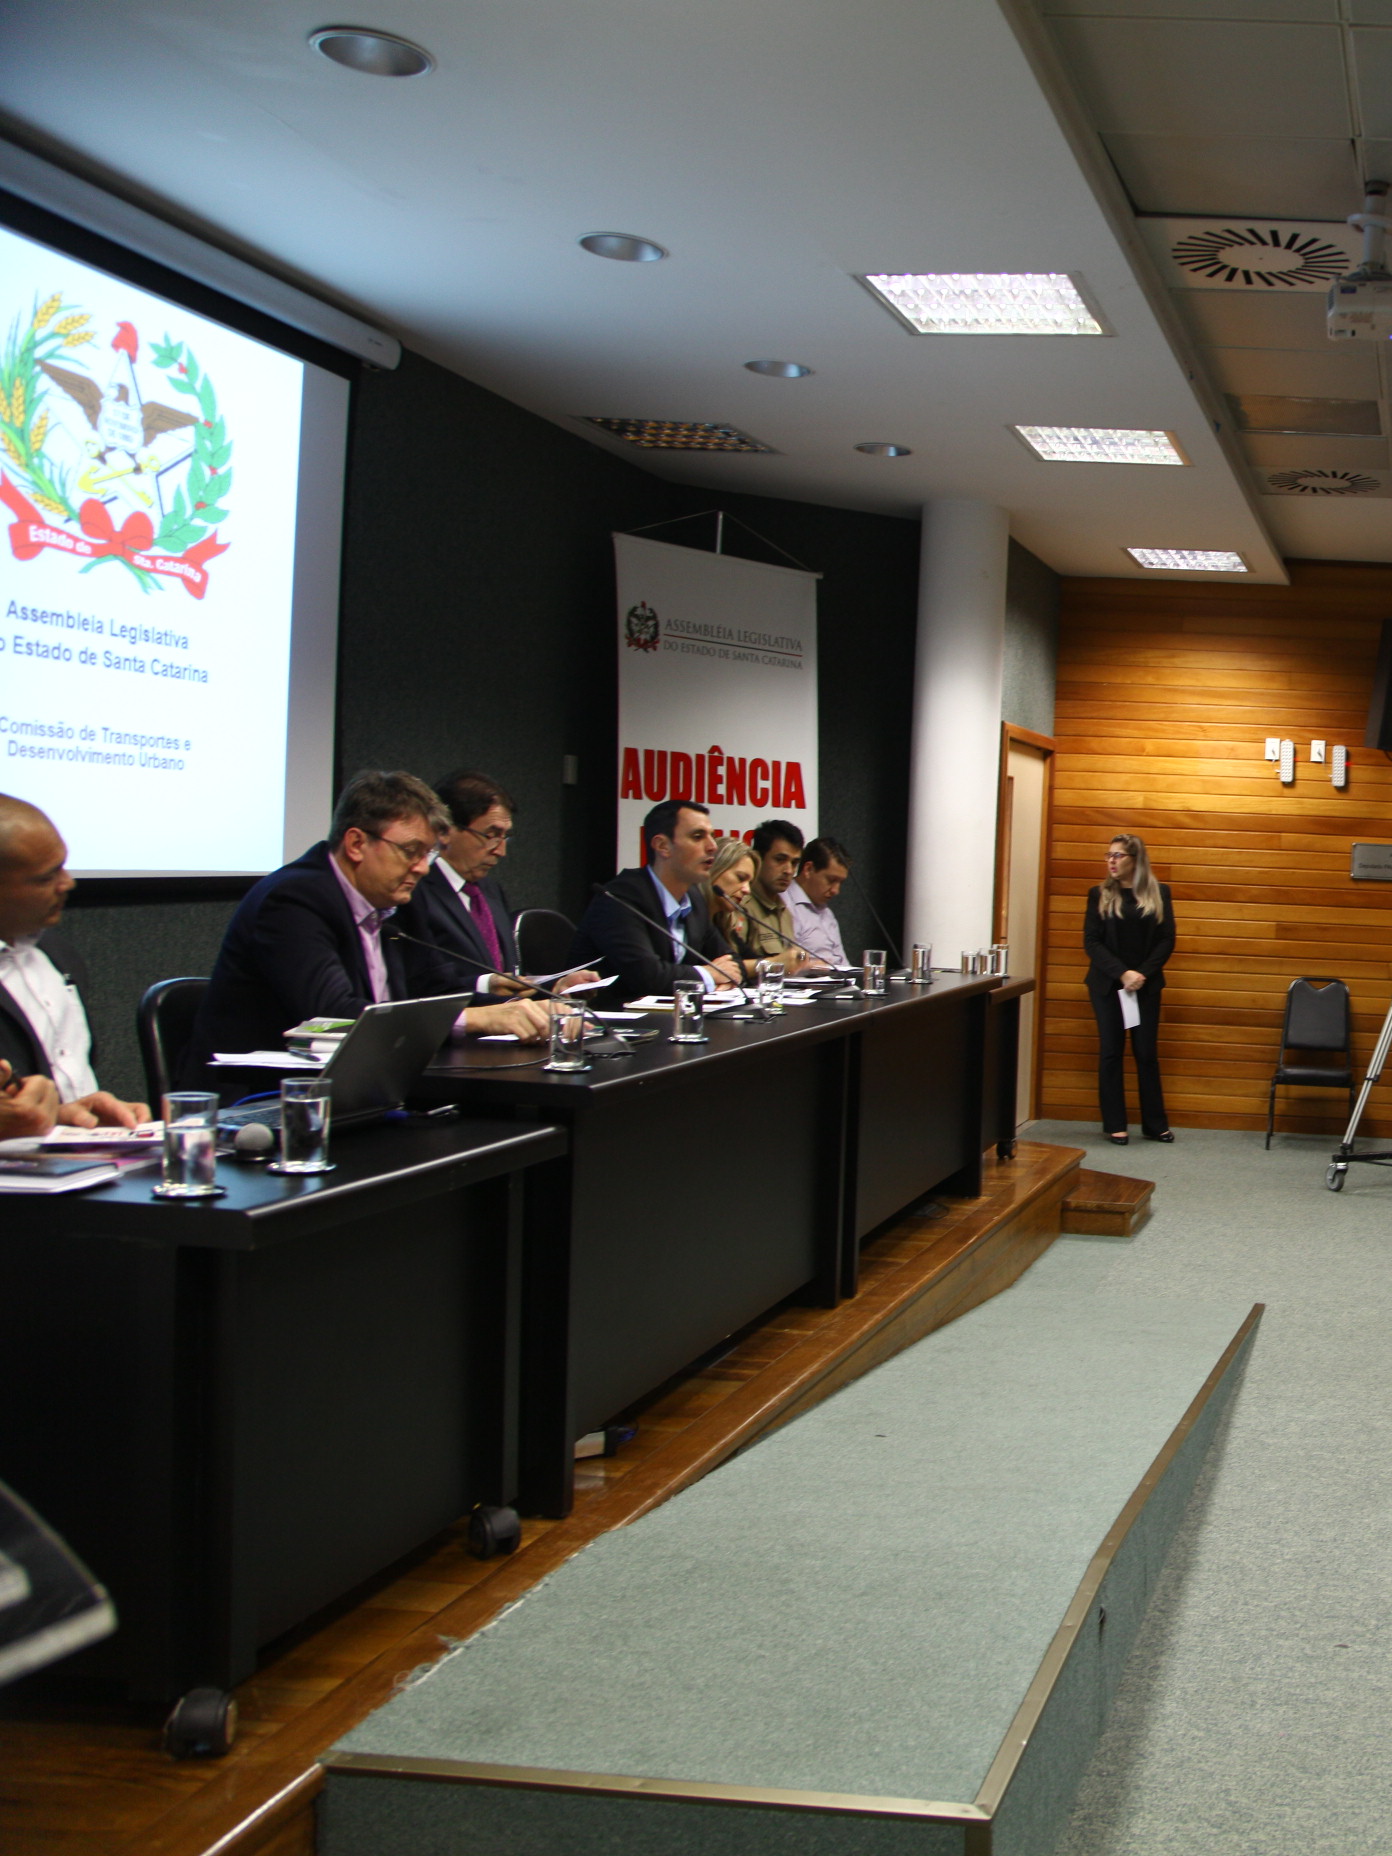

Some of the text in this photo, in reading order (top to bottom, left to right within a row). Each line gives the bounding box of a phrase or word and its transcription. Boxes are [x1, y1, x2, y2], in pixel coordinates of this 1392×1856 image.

[28, 525, 74, 549] Estado
[155, 559, 202, 582] Catarina
[6, 600, 189, 649] Assembleia Legislativa
[664, 618, 803, 651] ASSEMBLÉIA LEGISLATIVA
[13, 635, 72, 662] Estado
[79, 647, 97, 665] de
[103, 650, 146, 673] Santa
[150, 658, 208, 683] Catarina
[663, 640, 803, 670] DO ESTADO DE SANTA CATARINA
[0, 716, 191, 751] Comissão de Transportes e
[8, 739, 185, 771] Desenvolvimento Urbano
[620, 745, 806, 810] AUDIÊNCIA
